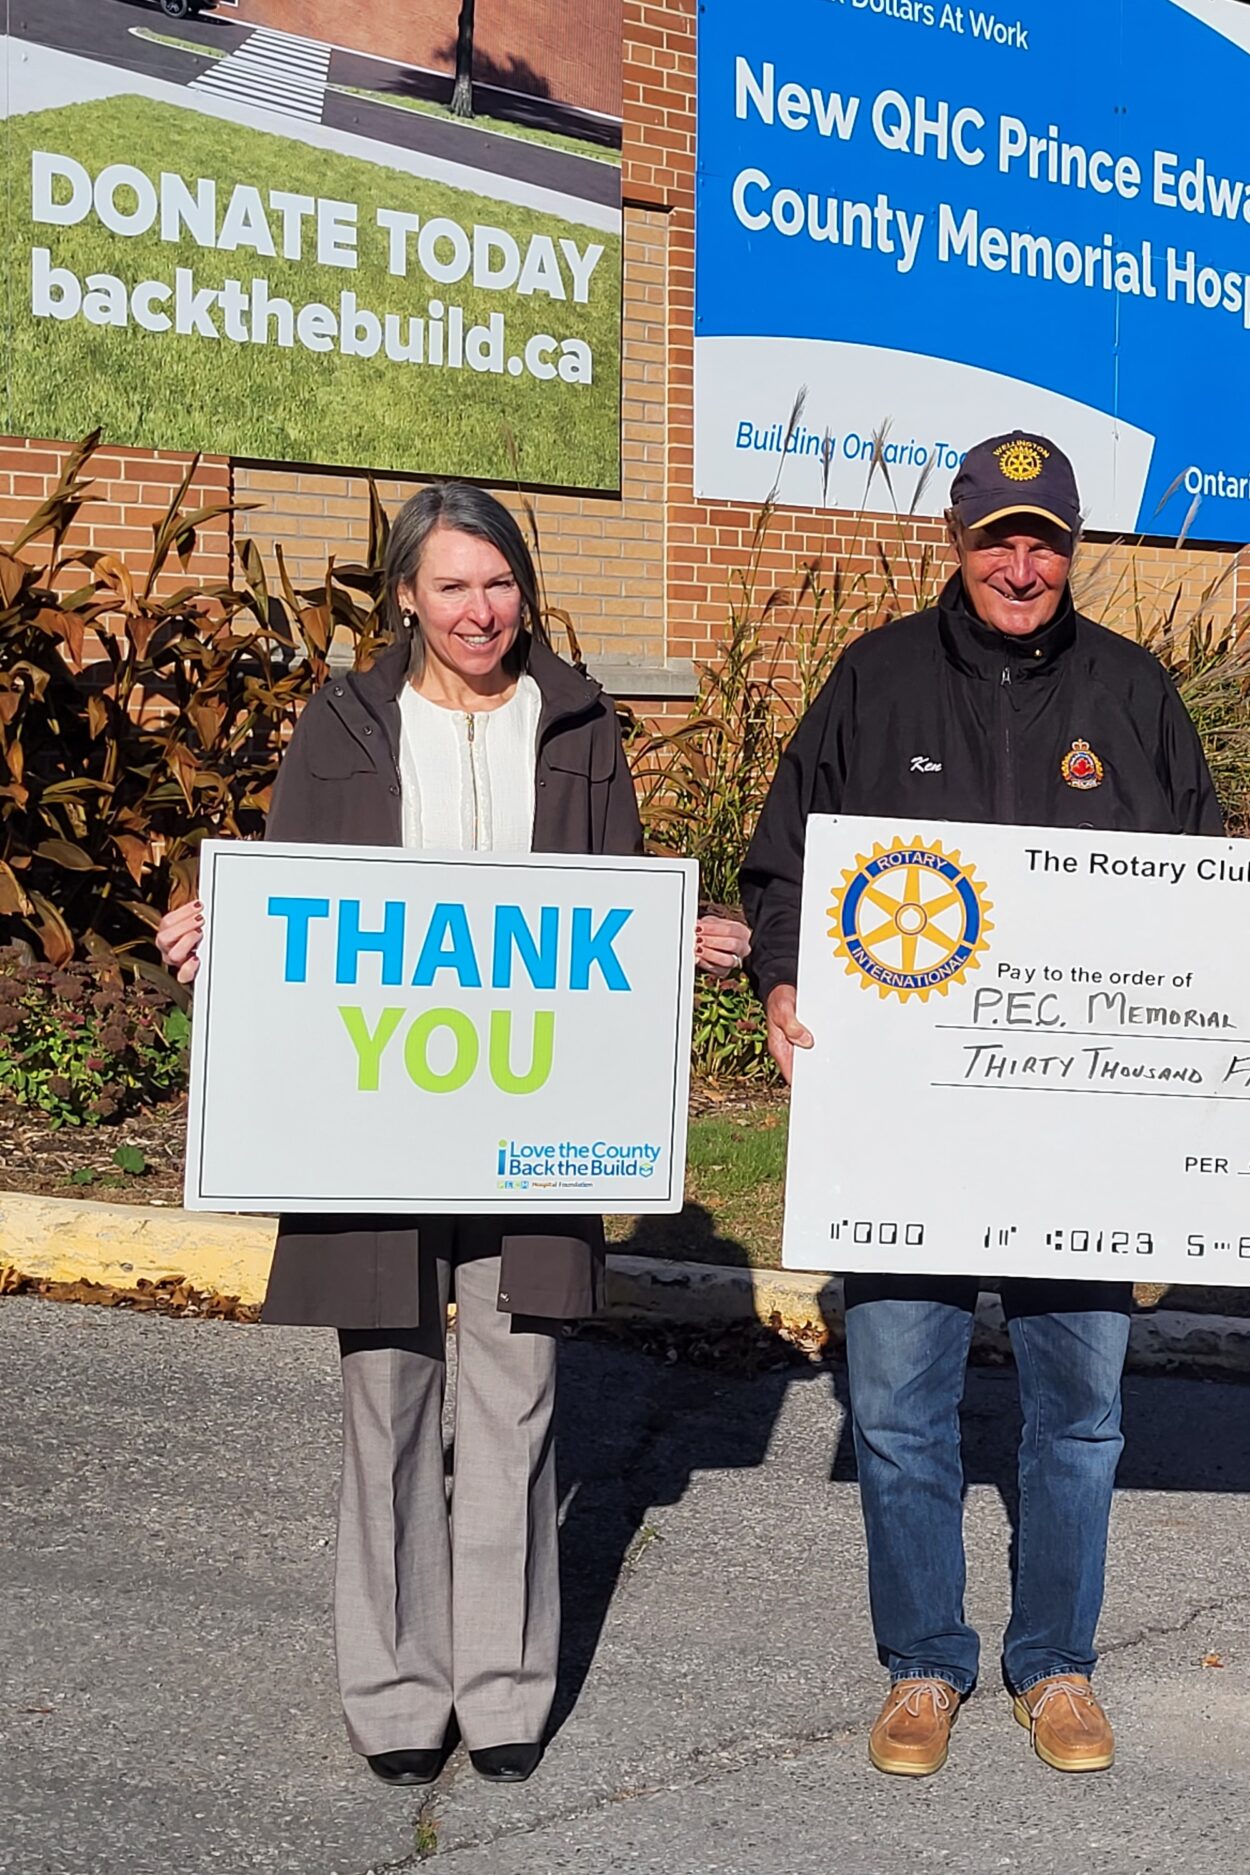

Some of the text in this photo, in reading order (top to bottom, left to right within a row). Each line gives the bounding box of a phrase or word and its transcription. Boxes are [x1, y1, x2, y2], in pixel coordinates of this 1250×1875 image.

[939, 3, 964, 33] At
[969, 9, 1029, 49] Work
[735, 56, 860, 140] New
[872, 90, 984, 166] QHC
[1000, 116, 1140, 199] Prince
[31, 150, 604, 303] DONATE TODAY
[732, 169, 924, 272] County
[938, 205, 1156, 298] Memorial
[31, 247, 593, 384] backthebuild.ca
[843, 433, 927, 466] Onario
[910, 756, 942, 772] Ken
[876, 851, 948, 871] ROTARY
[1025, 849, 1078, 873] The
[1089, 853, 1185, 884] Rotary
[267, 896, 634, 992] THANK
[851, 947, 967, 988] INTERNATIONAL
[998, 963, 1194, 988] Pay to the order of
[338, 1005, 556, 1095] YOU
[510, 1141, 555, 1158] Love
[559, 1142, 590, 1159] the
[592, 1142, 661, 1163] County
[510, 1159, 637, 1176] Back the Build
[1184, 1156, 1229, 1174] PER
